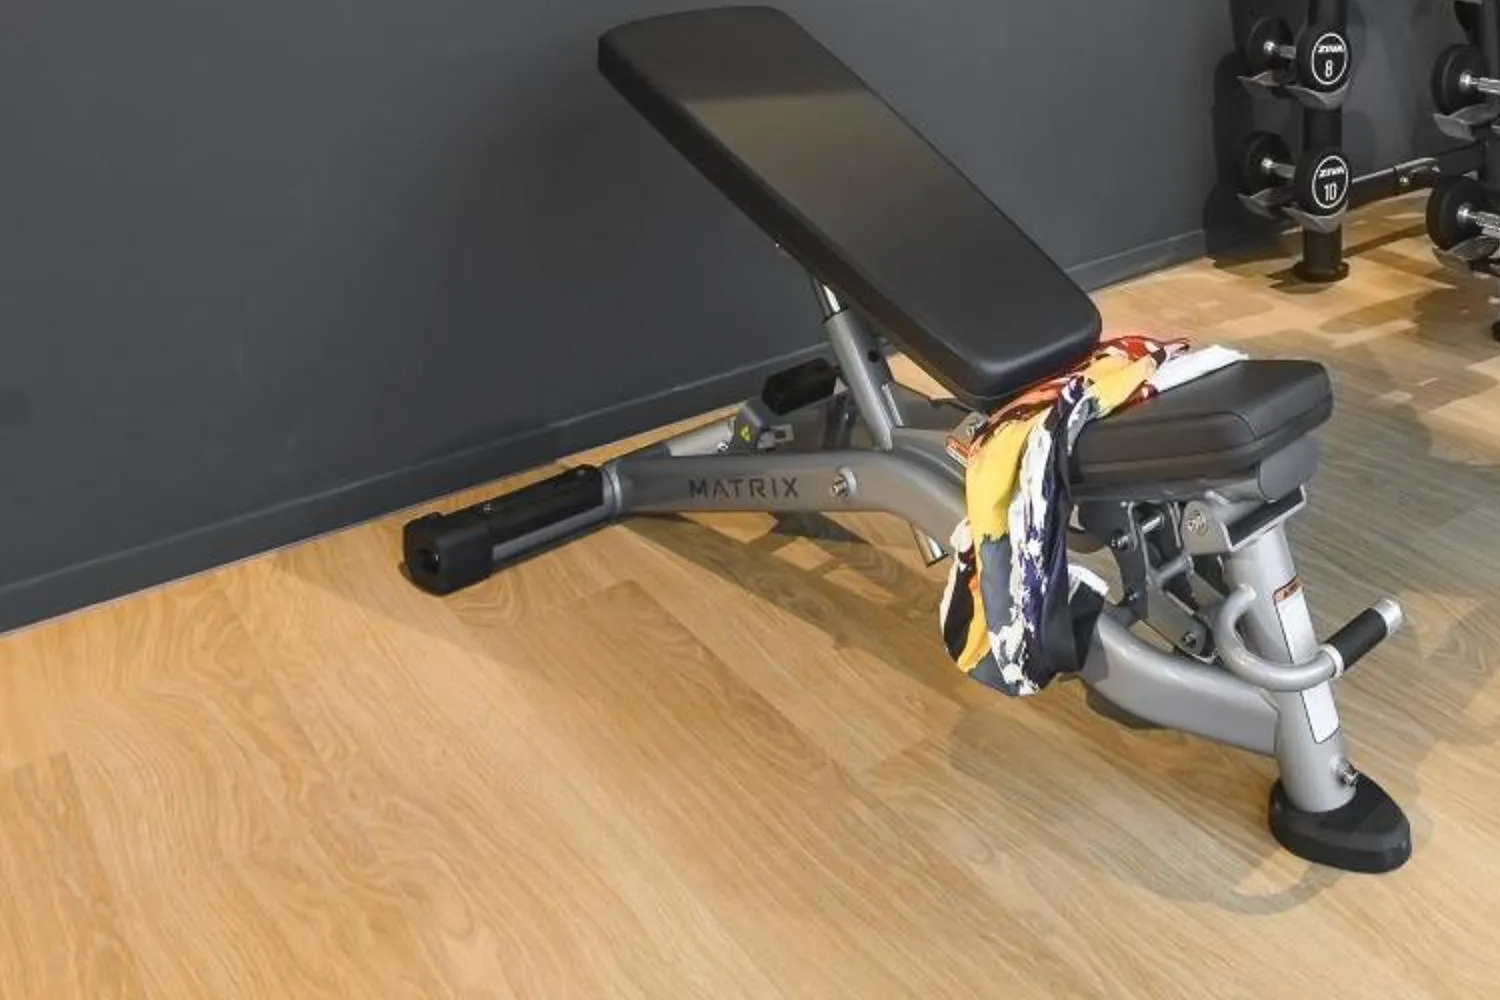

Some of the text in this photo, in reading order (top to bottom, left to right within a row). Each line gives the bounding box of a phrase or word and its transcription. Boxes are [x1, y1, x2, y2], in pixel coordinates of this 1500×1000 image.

[1324, 58, 1334, 79] 8
[1323, 181, 1338, 202] 10
[689, 476, 800, 499] MATRIX
